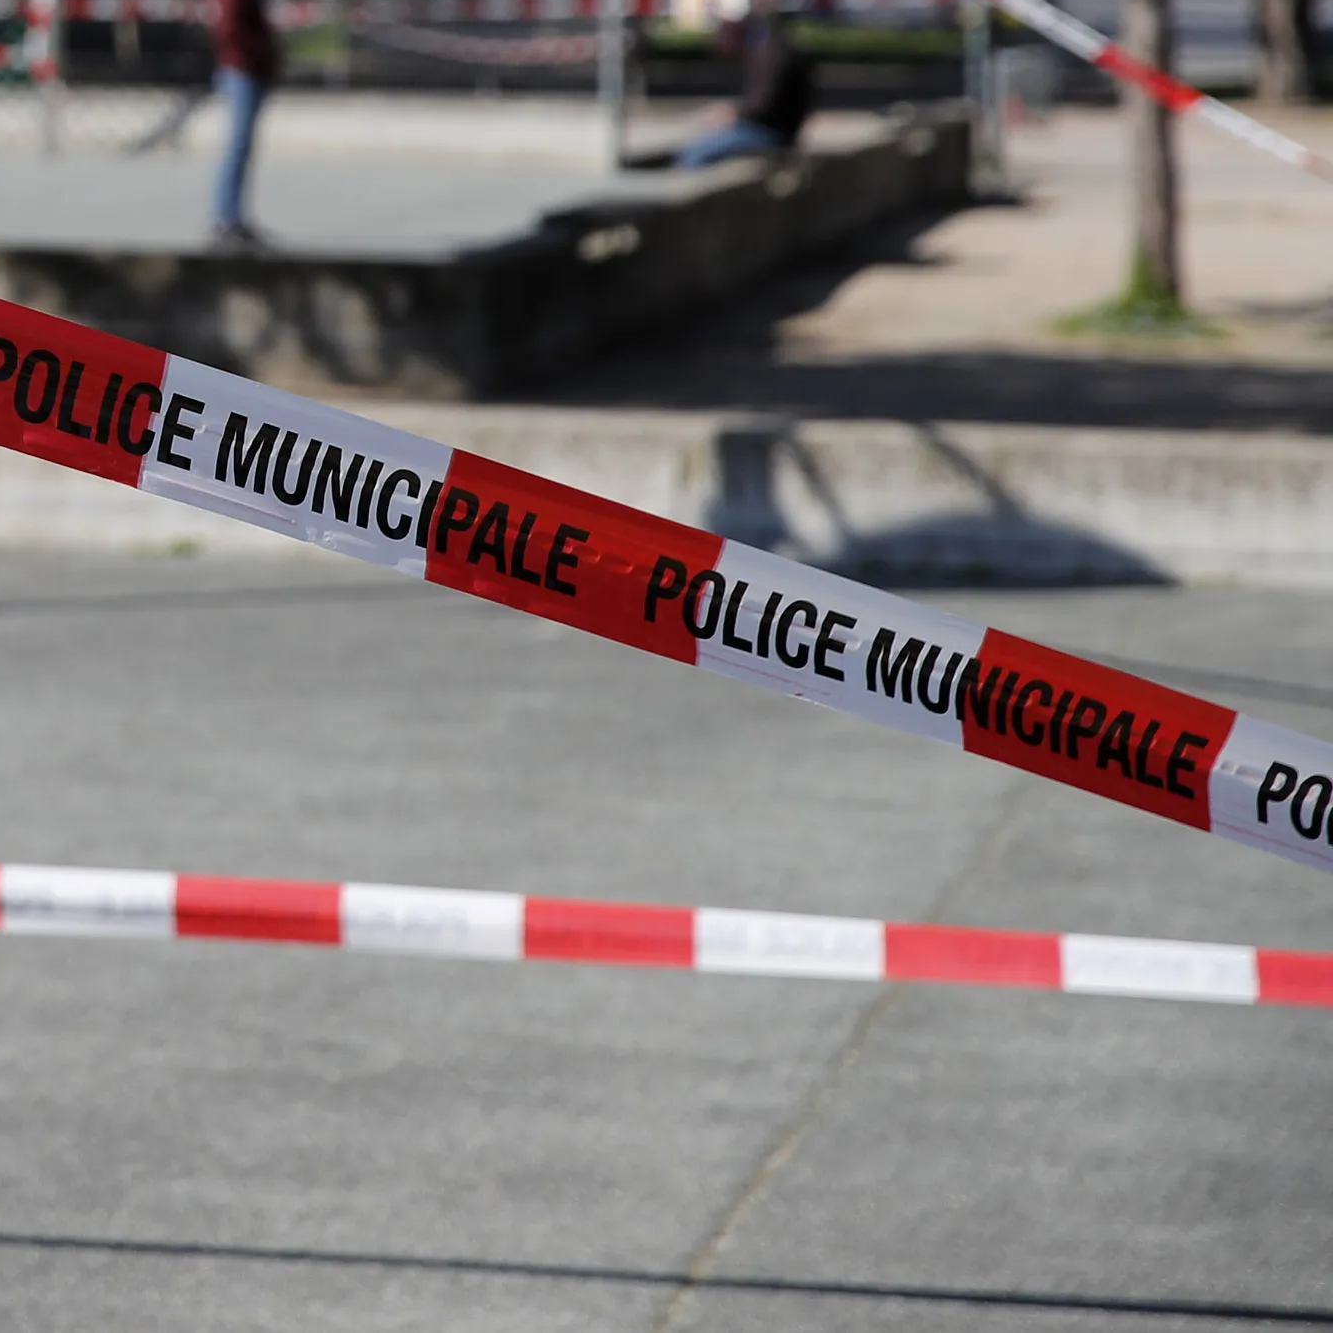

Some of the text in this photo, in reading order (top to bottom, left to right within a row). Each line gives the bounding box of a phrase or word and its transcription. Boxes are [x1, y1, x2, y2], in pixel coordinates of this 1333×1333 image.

[214, 412, 590, 597] MUNICIPALE
[644, 556, 1209, 799] POLICE MUNICIPALE
[1256, 761, 1333, 846] PO
